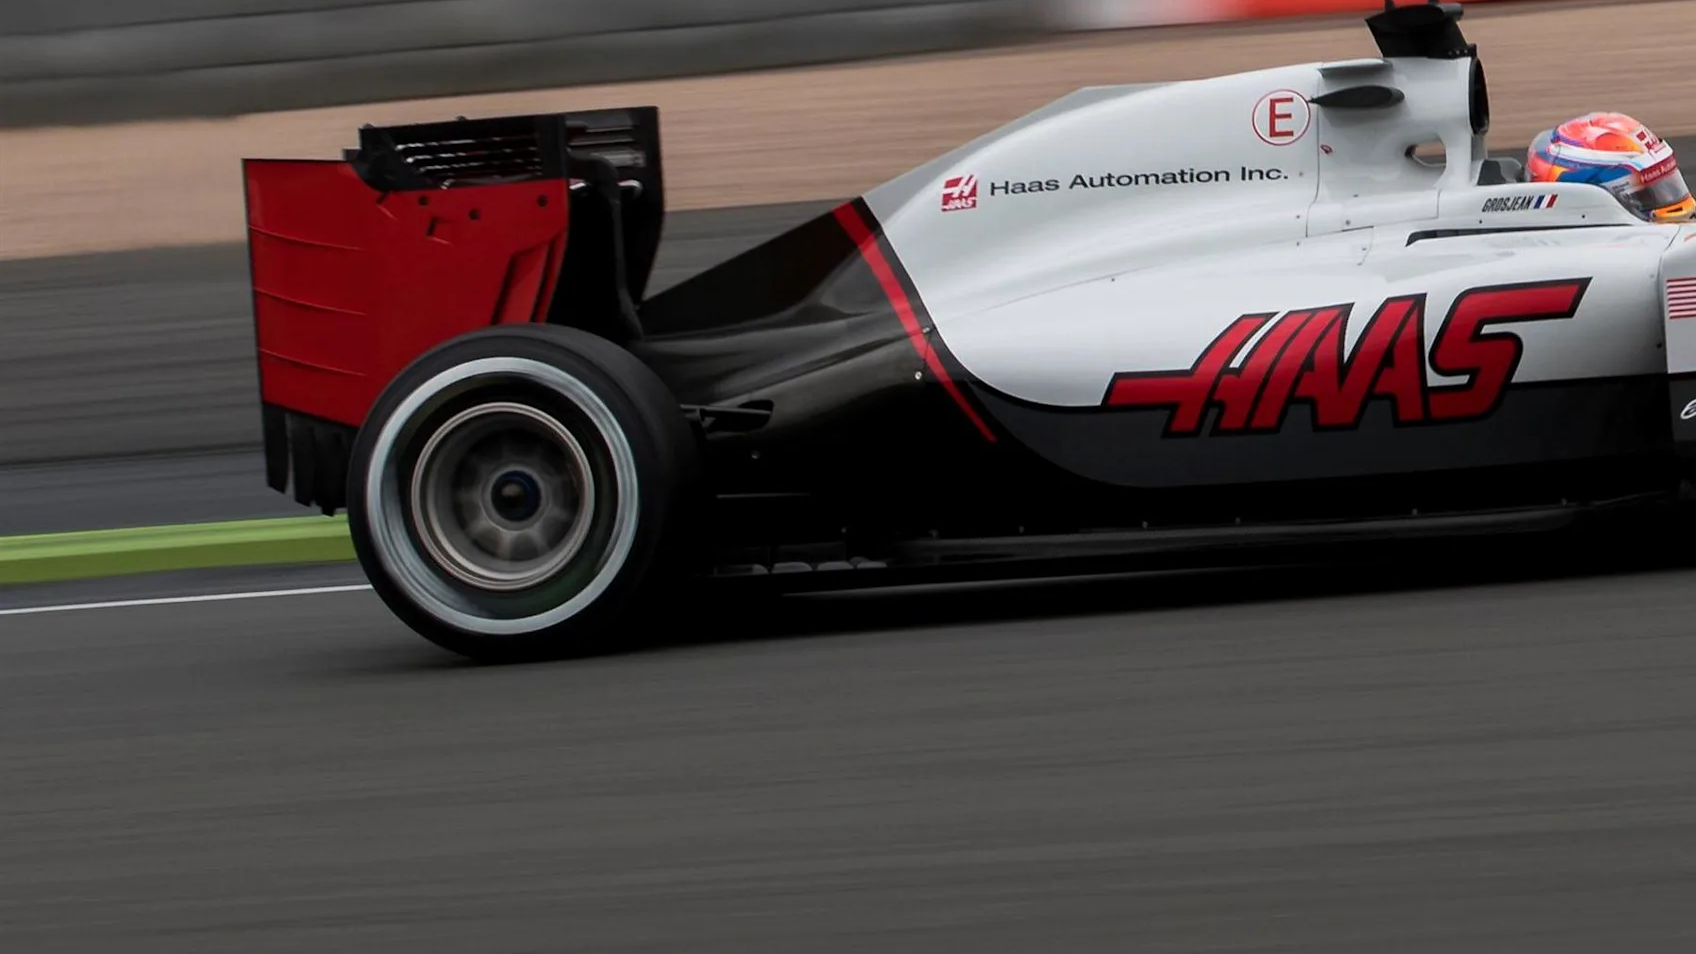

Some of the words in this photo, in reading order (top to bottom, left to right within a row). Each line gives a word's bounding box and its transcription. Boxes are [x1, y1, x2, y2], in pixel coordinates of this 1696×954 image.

[1269, 97, 1294, 138] E
[990, 179, 1060, 196] Haas
[1068, 168, 1230, 189] Automation
[1240, 166, 1288, 181] Inc.
[1481, 195, 1534, 212] GROSJEAN
[1100, 277, 1592, 438] HAAS
